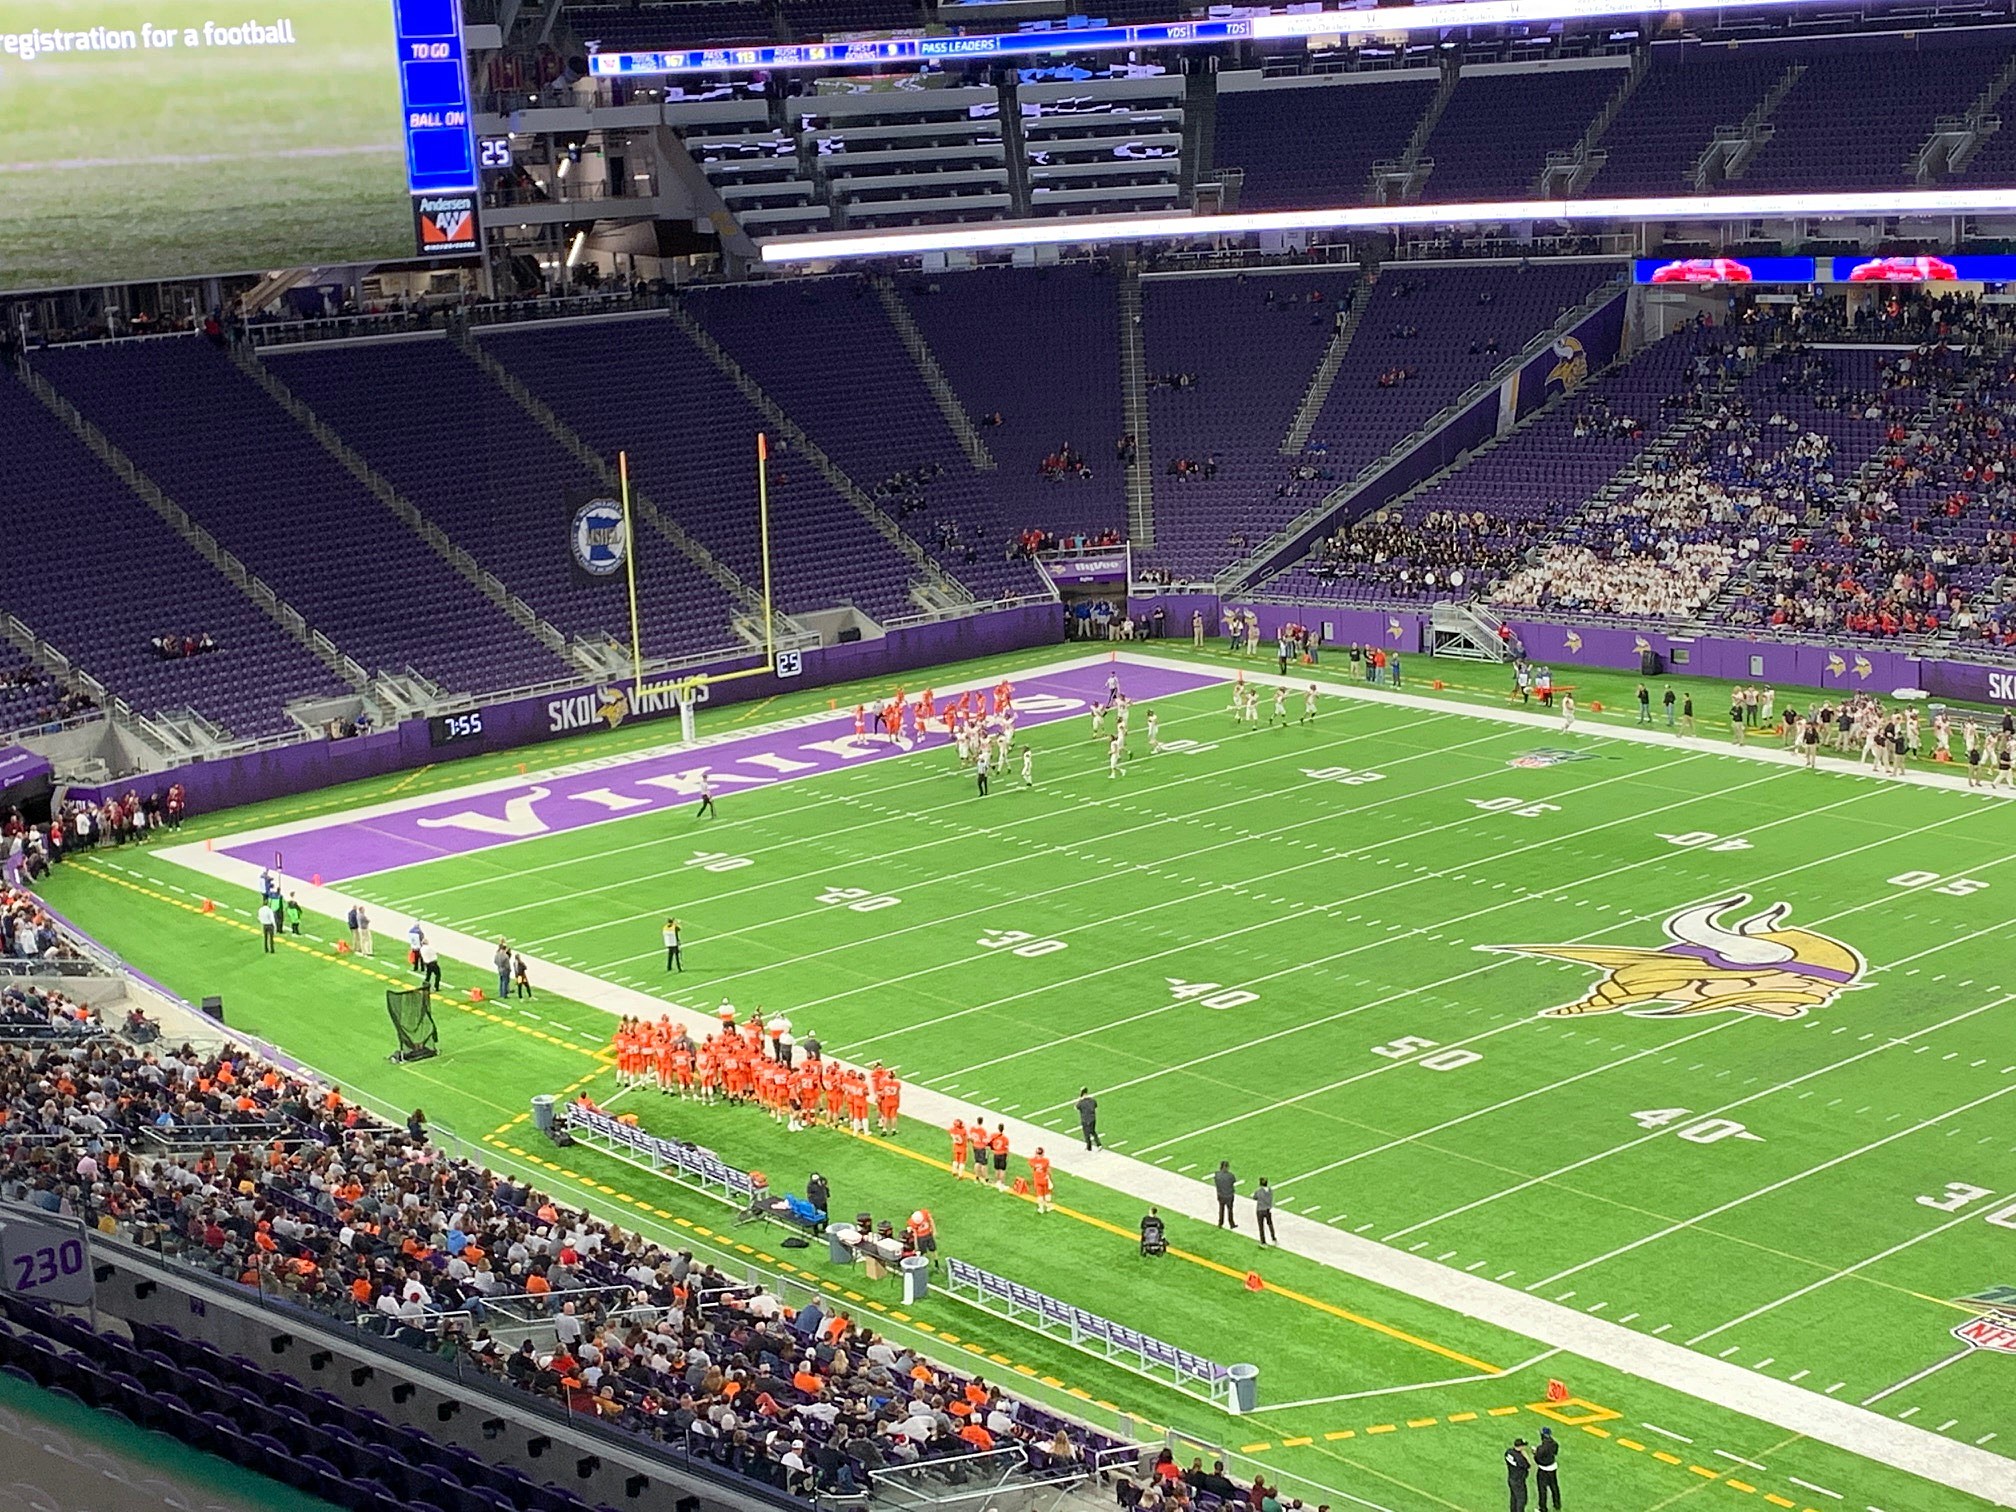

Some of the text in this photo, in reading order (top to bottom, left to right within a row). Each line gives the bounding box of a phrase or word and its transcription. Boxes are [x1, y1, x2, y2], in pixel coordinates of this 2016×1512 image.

[141, 23, 178, 48] for
[183, 28, 199, 47] a
[203, 18, 296, 46] football
[1166, 26, 1187, 38] YDS
[1226, 22, 1246, 35] TDS
[411, 43, 450, 58] TO GO
[736, 51, 756, 64] 113
[922, 39, 994, 54] PASS LEADERS
[663, 54, 684, 68] 167
[410, 111, 464, 128] BALL ON
[481, 140, 510, 166] 25
[420, 197, 471, 212] Andersen
[780, 654, 800, 673] 25
[1988, 672, 2016, 700] SK
[549, 673, 710, 732] SKOL VIKINGS
[445, 713, 482, 735] 7:55
[1160, 739, 1220, 755] 10
[1306, 766, 1387, 786] 20
[1476, 796, 1562, 818] 30
[1667, 831, 1755, 852] 40
[684, 851, 755, 872] 10
[1886, 870, 1990, 897] 50
[814, 887, 903, 912] 20
[975, 929, 1069, 957] 30
[1168, 982, 1261, 1010] 40
[1370, 1035, 1484, 1071] 50
[1629, 1107, 1747, 1144] 40
[13, 1238, 83, 1291] 230
[1961, 1322, 2016, 1350] NFL
